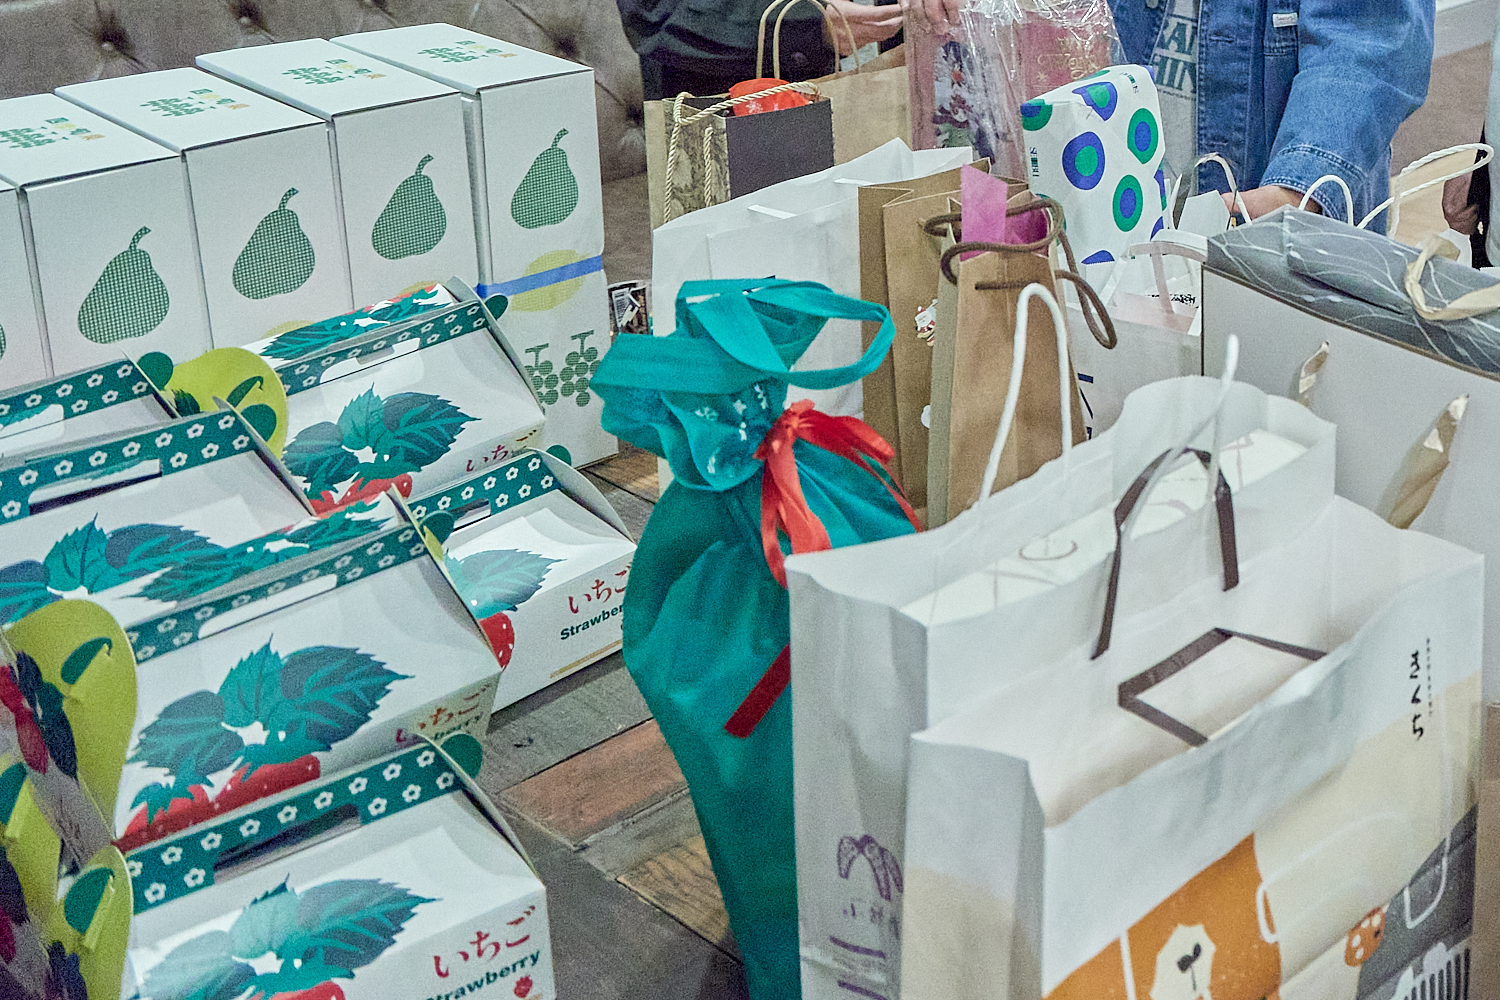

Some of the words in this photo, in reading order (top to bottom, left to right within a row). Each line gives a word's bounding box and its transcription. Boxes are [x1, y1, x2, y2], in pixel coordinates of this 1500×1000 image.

[568, 561, 633, 615] いちご
[433, 905, 536, 978] いちご
